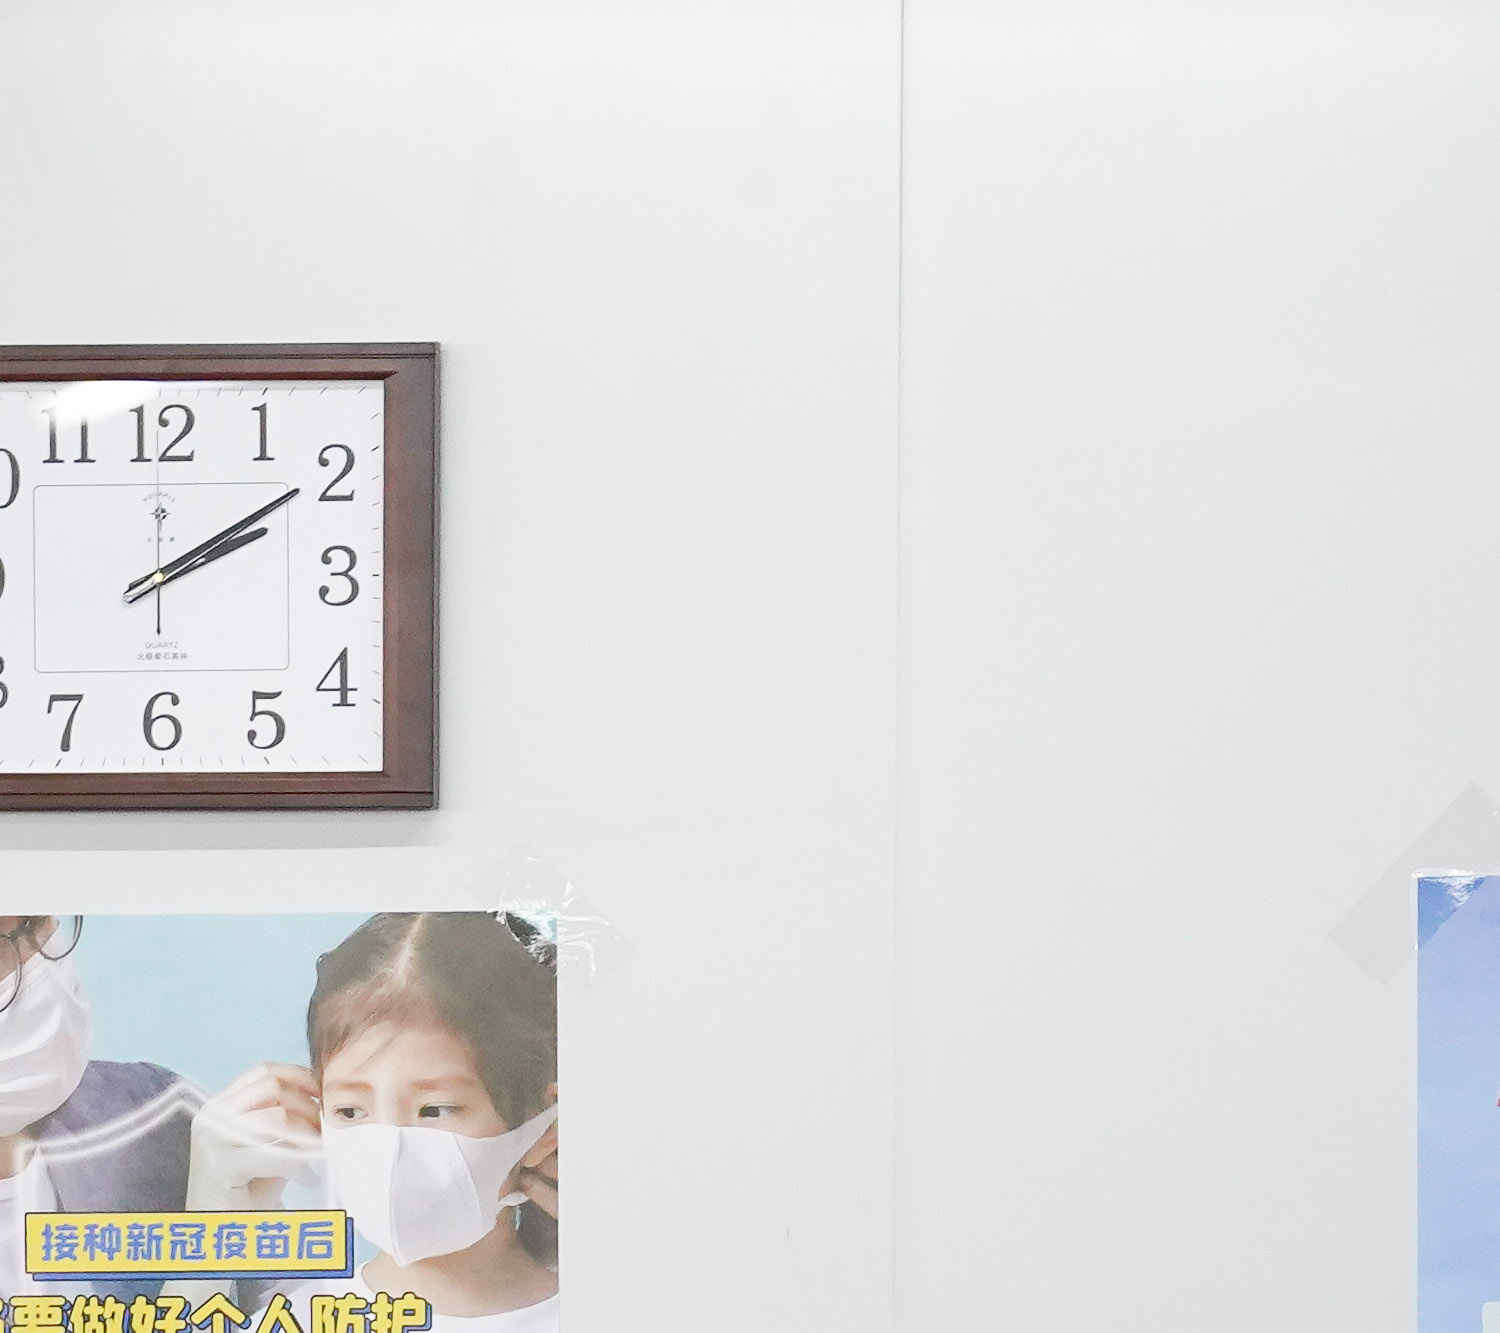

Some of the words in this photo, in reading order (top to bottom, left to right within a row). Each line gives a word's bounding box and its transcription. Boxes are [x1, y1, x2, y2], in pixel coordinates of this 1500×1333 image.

[129, 404, 195, 462] 12
[251, 403, 275, 461] 1
[317, 444, 355, 502] 2
[318, 546, 359, 606] 3
[315, 647, 358, 707] 4
[46, 694, 84, 752] 7
[142, 692, 183, 750] 6
[247, 691, 285, 749] 5
[41, 1220, 336, 1262] 接种新冠疫苗后
